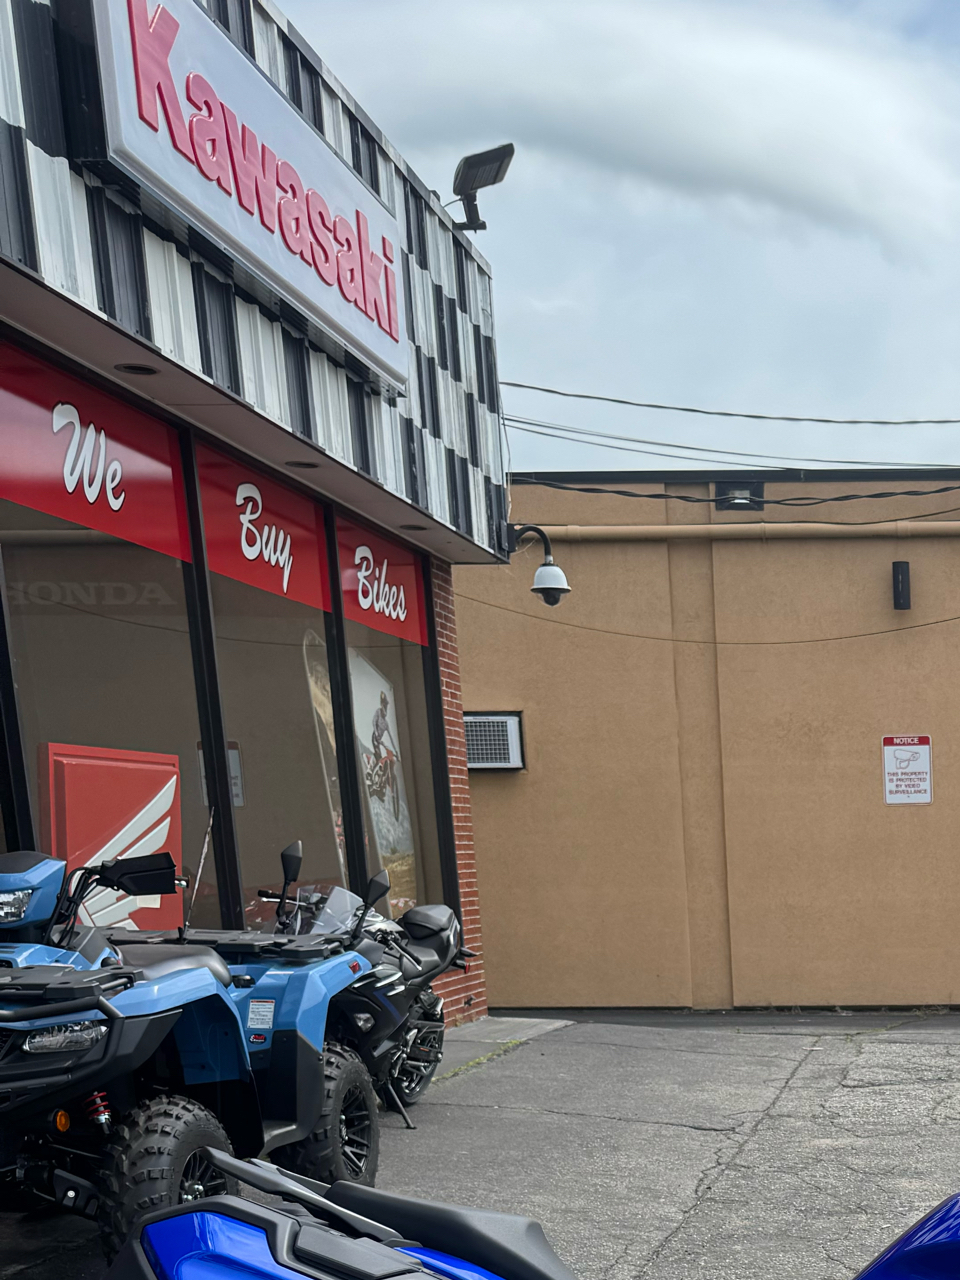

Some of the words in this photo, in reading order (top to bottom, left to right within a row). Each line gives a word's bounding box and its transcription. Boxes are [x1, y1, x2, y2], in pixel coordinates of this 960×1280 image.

[127, 0, 399, 343] Kawasaki
[52, 402, 125, 511] We
[236, 483, 293, 594] Buy
[354, 545, 407, 622] Bikes
